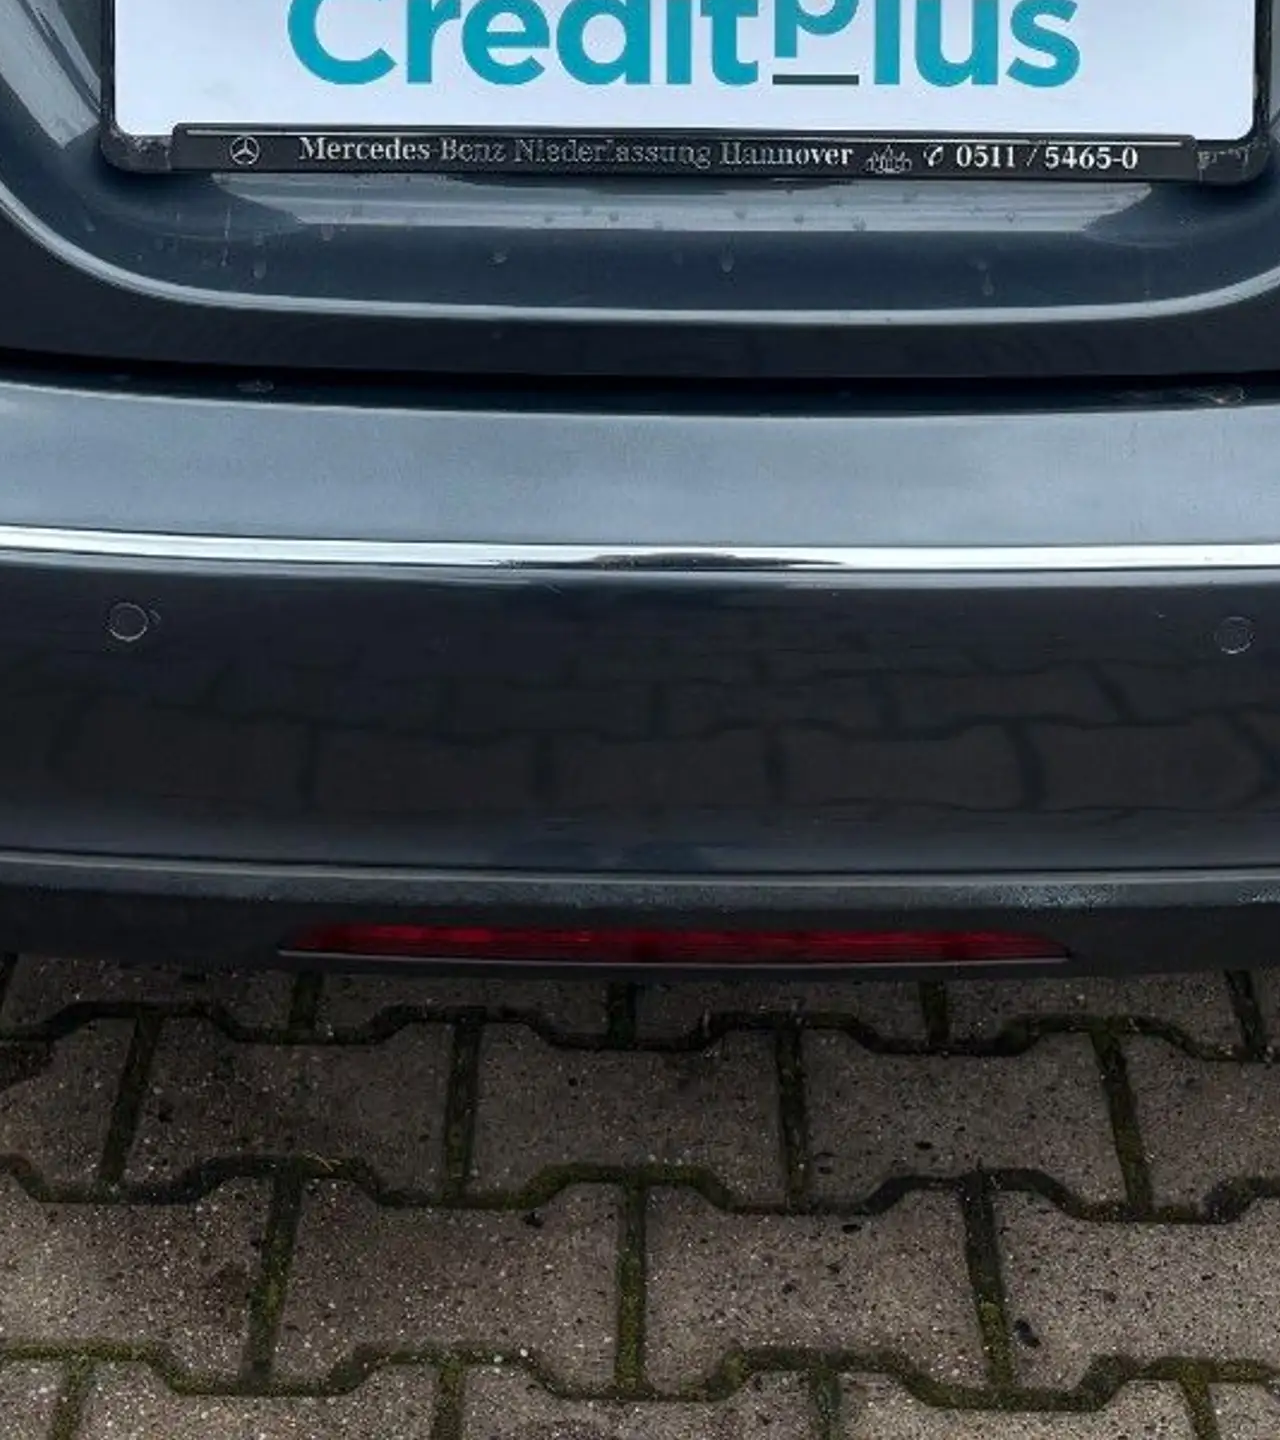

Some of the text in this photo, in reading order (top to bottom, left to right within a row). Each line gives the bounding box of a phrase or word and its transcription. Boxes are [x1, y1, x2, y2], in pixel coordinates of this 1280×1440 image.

[299, 136, 506, 162] Mercedes-Benz
[515, 138, 711, 169] Niederlassung
[721, 141, 853, 167] Hannover
[956, 145, 1016, 169] 0511
[1044, 146, 1138, 170] 5465-0
